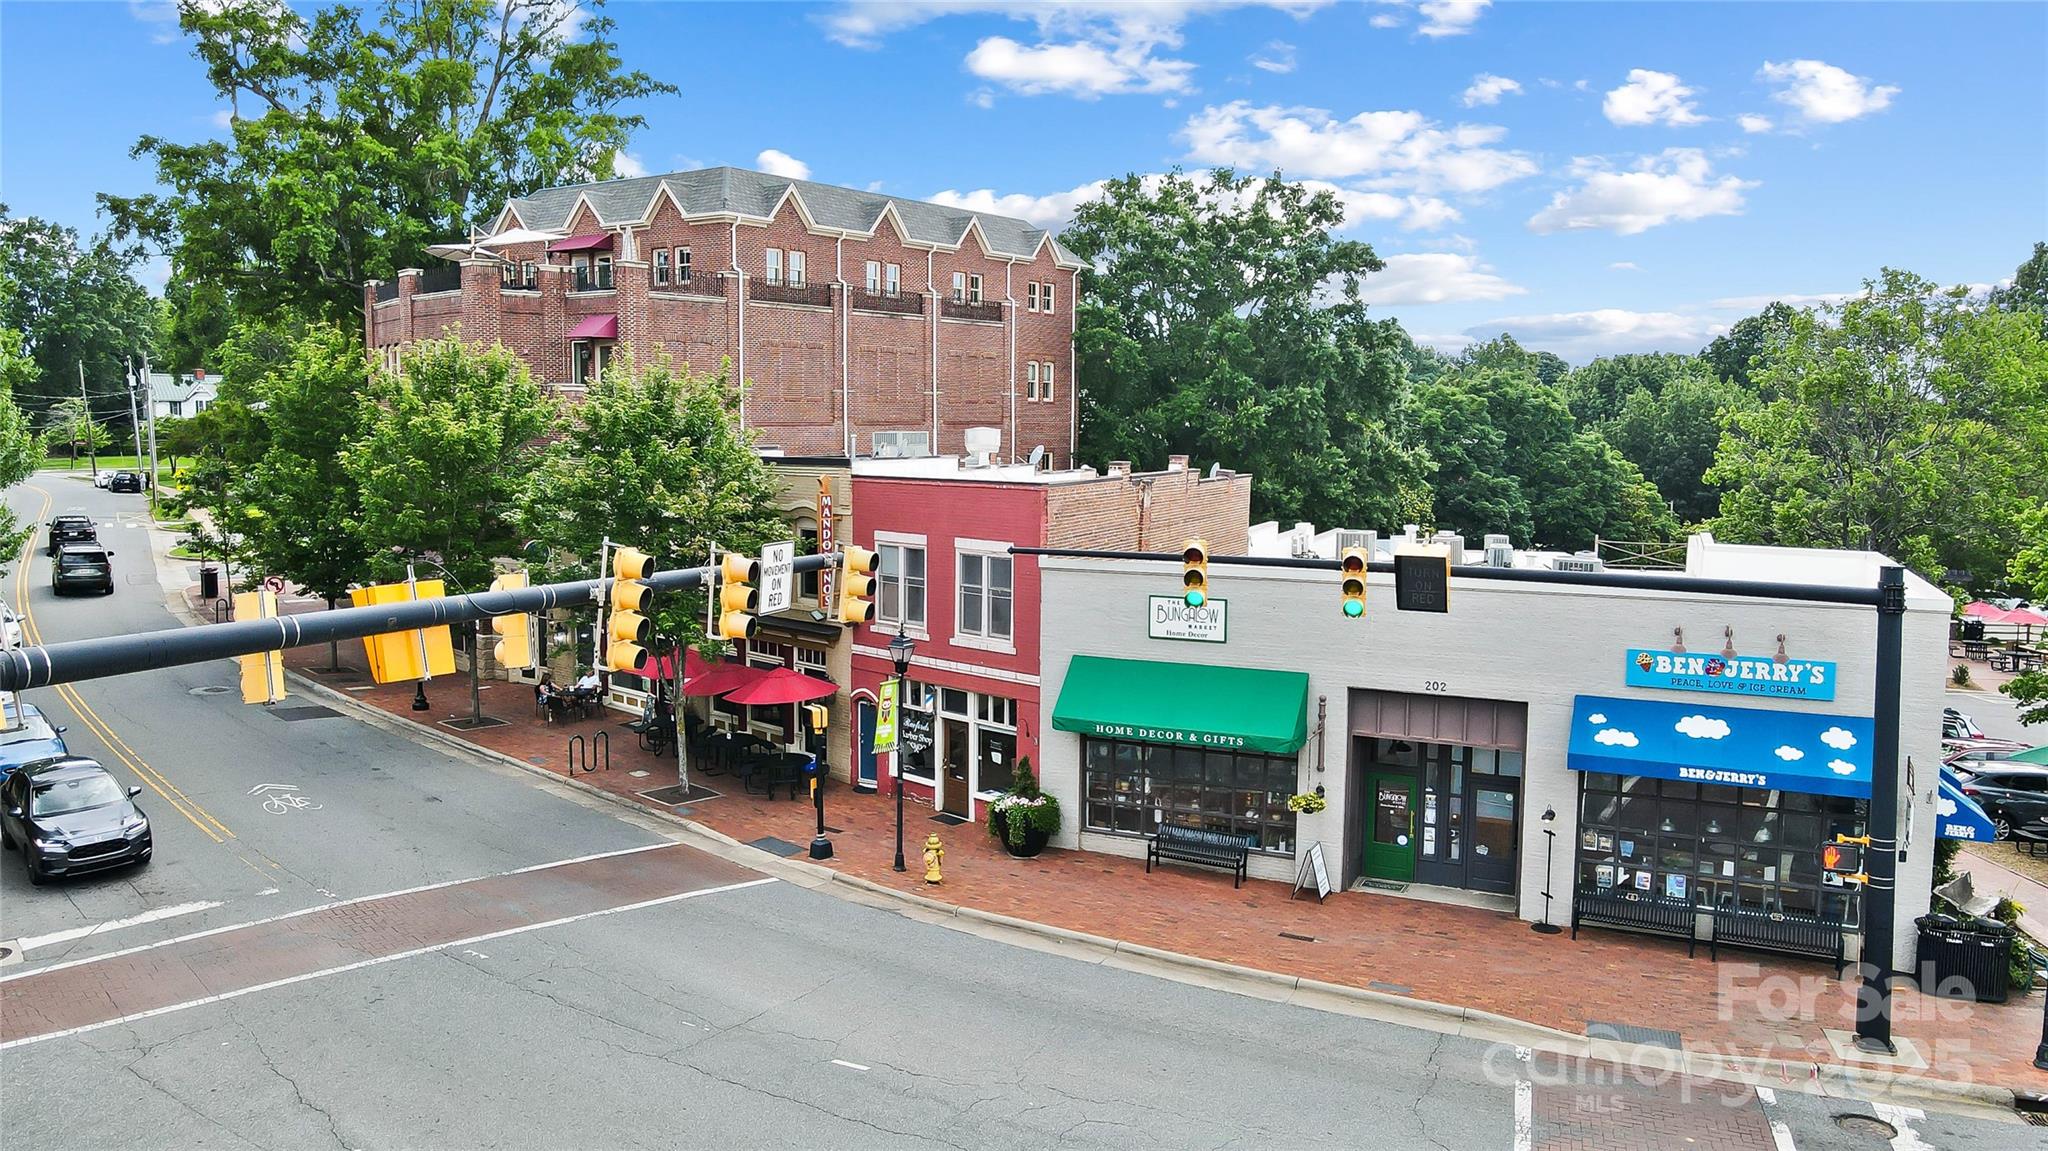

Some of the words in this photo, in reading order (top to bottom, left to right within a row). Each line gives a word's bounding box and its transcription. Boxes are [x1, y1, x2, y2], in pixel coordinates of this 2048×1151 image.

[773, 549, 783, 562] NO
[763, 563, 791, 577] MOVEMENT
[1408, 567, 1440, 578] TURN
[771, 578, 782, 591] ON
[1415, 580, 1432, 592] ON
[768, 592, 783, 607] RED
[1411, 592, 1434, 604] RED
[1156, 604, 1219, 623] BUNGALOW
[1656, 655, 1705, 676] BEN
[1724, 660, 1825, 684] JERRY'S
[1425, 680, 1447, 692] 202
[1671, 677, 1704, 688] PEACE,
[1708, 680, 1734, 690] LOVE
[1750, 684, 1766, 693] ICE
[1769, 685, 1807, 695] CREAM
[1096, 724, 1134, 736] HOME
[1139, 729, 1184, 741] DECOR
[1189, 733, 1198, 742] &
[1203, 734, 1244, 746] GIFTS
